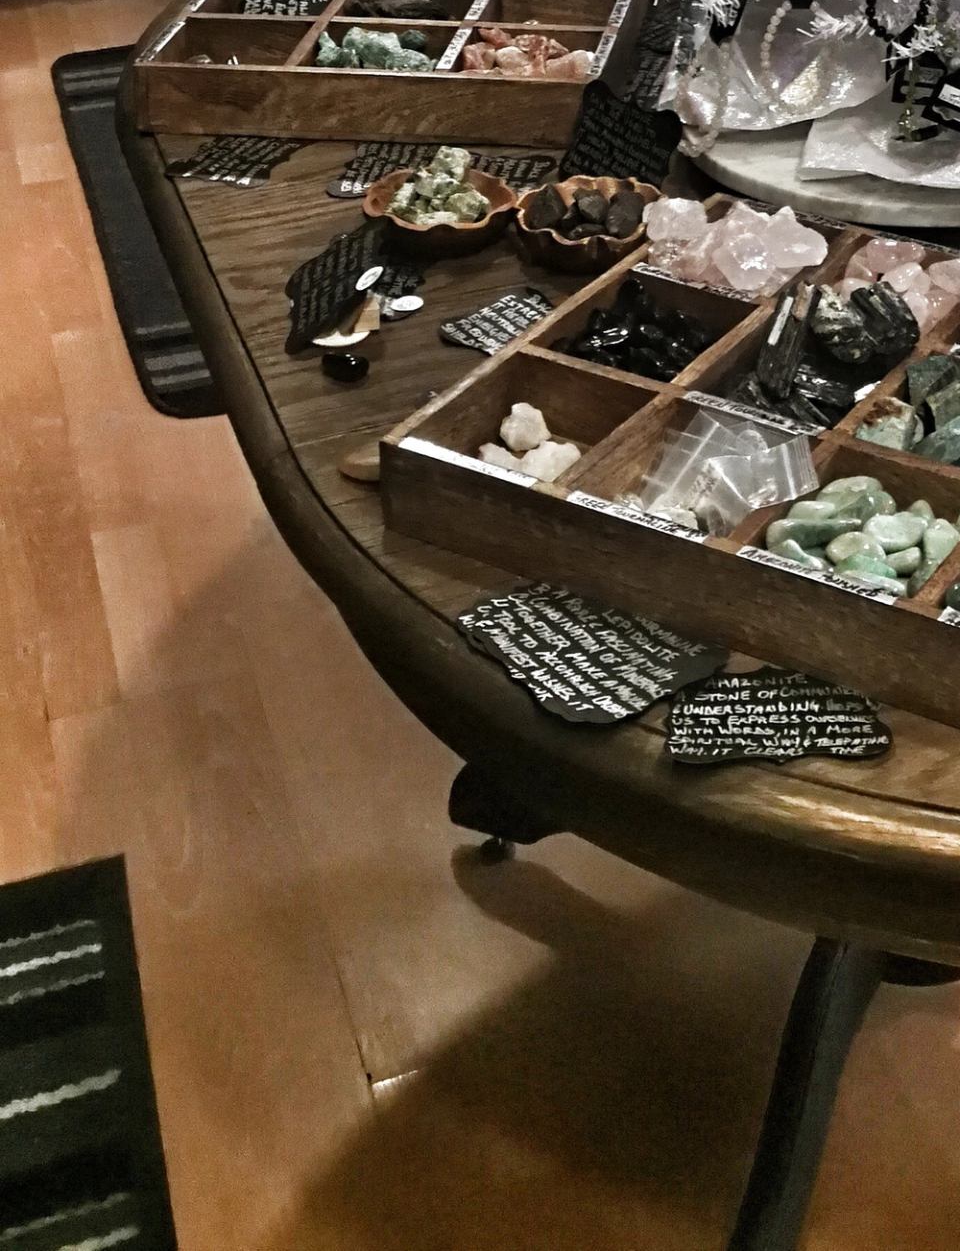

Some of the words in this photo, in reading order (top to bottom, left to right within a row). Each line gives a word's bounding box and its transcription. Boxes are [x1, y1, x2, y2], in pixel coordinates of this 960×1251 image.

[493, 609, 522, 636] TOOL
[518, 633, 539, 650] TO
[529, 597, 603, 655] COMBINATION
[599, 651, 622, 666] OF
[602, 608, 680, 663] LEPIDOLITE
[512, 606, 571, 652] TOGETHER
[564, 650, 609, 681] MAKE
[704, 674, 809, 689] AMAZONITE
[694, 691, 751, 702] STONE
[757, 690, 781, 700] OF
[573, 700, 595, 713] IT
[671, 718, 697, 727] US
[699, 717, 722, 726] TO
[727, 714, 802, 728] EXPRESS
[674, 726, 715, 737] WITH
[783, 727, 801, 737] IN
[807, 726, 818, 735] A
[825, 724, 874, 735] MORE
[762, 736, 801, 748] WAY
[712, 747, 730, 757] IT
[831, 746, 865, 756] THE
